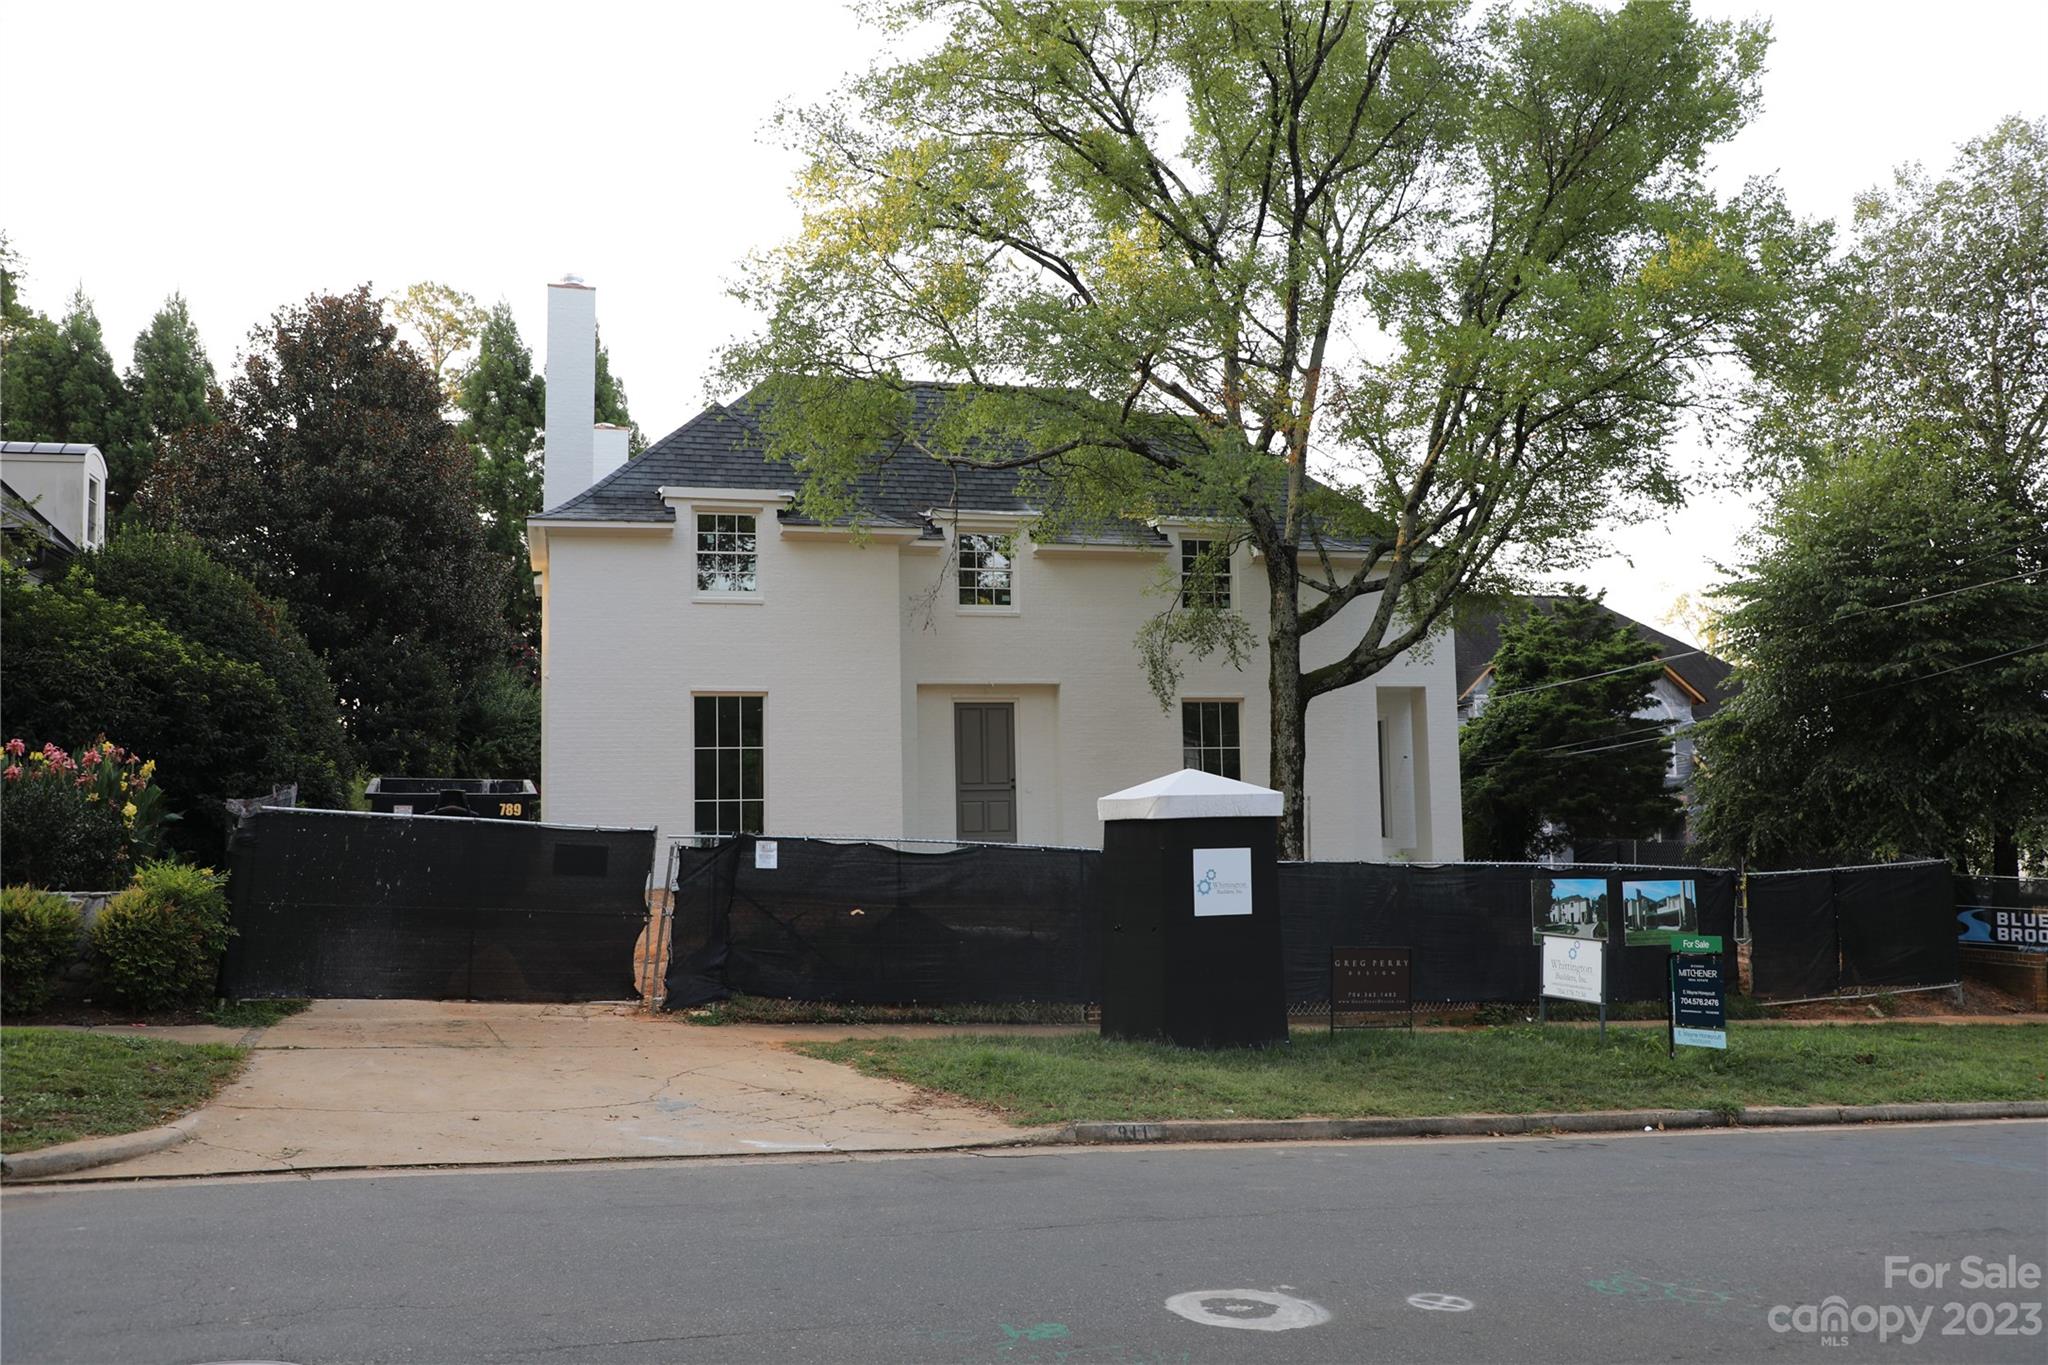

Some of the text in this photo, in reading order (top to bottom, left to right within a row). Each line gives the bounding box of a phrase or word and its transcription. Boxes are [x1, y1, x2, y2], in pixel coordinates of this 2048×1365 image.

[499, 803, 522, 816] 789
[1996, 912, 2048, 928] BLUE
[1682, 939, 1710, 949] For Sale
[1334, 959, 1408, 968] GREG PERRY
[1551, 959, 1592, 977] Whittington
[1678, 968, 1718, 978] MITCHENER
